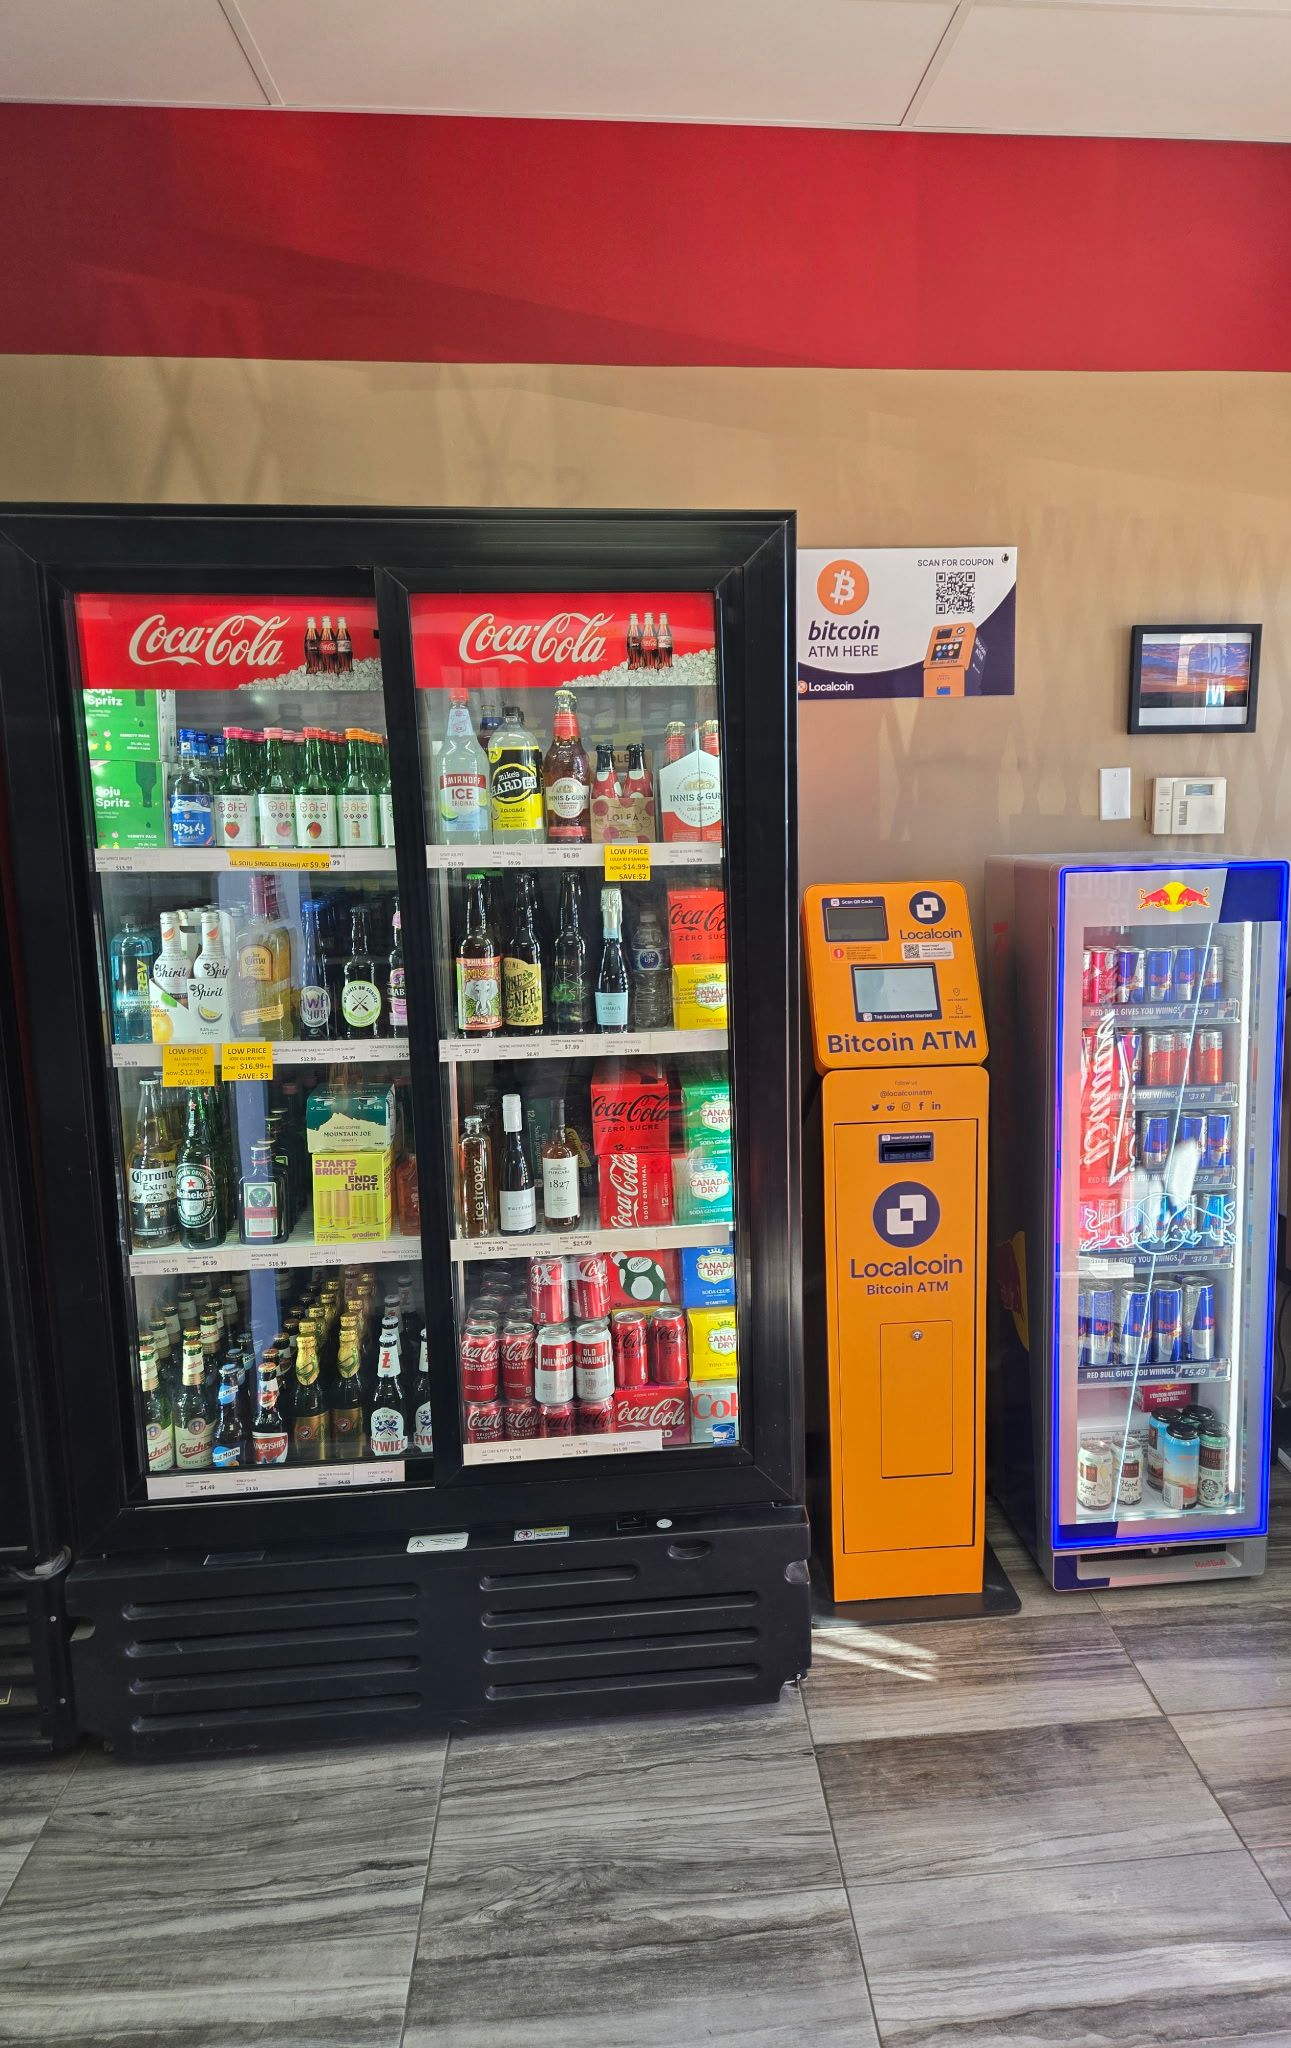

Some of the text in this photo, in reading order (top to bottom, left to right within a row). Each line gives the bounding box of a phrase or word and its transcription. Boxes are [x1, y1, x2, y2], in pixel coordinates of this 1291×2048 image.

[917, 558, 994, 567] SCAN FOR COUPON
[807, 620, 880, 641] bitcoin
[129, 614, 291, 666] Coca-Cola
[458, 612, 614, 664] Coca-Cola
[808, 645, 879, 658] ATM HERE
[808, 681, 855, 692] Localcoin
[87, 696, 123, 707] Spritz
[95, 787, 121, 797] Soju
[451, 789, 474, 800] ICE
[670, 793, 704, 802] INNIS &
[95, 798, 131, 808] Spritz
[310, 861, 330, 869] $9.99
[899, 928, 963, 940] Localcoin
[192, 984, 224, 1000] Spirit
[1090, 1008, 1103, 1016] RED
[1141, 1007, 1155, 1015] YOU
[827, 1030, 977, 1053] Bitcoin ATM
[246, 1047, 267, 1055] PRICE
[240, 1063, 270, 1071] $16.99++
[879, 1090, 933, 1098] @localcoinatm
[711, 1116, 730, 1124] DRY
[315, 1159, 357, 1168] STARTS
[315, 1167, 357, 1176] BRIGHT.
[131, 1170, 176, 1185] Corona
[347, 1175, 379, 1183] ENDS
[142, 1183, 168, 1191] Extra
[344, 1182, 379, 1191] LIGHT.
[549, 1179, 570, 1190] 1827
[690, 1179, 729, 1187] CANADA
[472, 1158, 484, 1222] ice tropez
[661, 1197, 669, 1207] 12
[351, 1231, 381, 1239] gradient
[1119, 1256, 1136, 1264] GIVES
[697, 1262, 735, 1270] CANADA
[850, 1254, 963, 1278] Localcoin
[866, 1281, 949, 1295] Bitcoin ATM
[582, 1348, 596, 1356] OLD
[1184, 1368, 1206, 1376] $5.49
[222, 1447, 240, 1458] MOON
